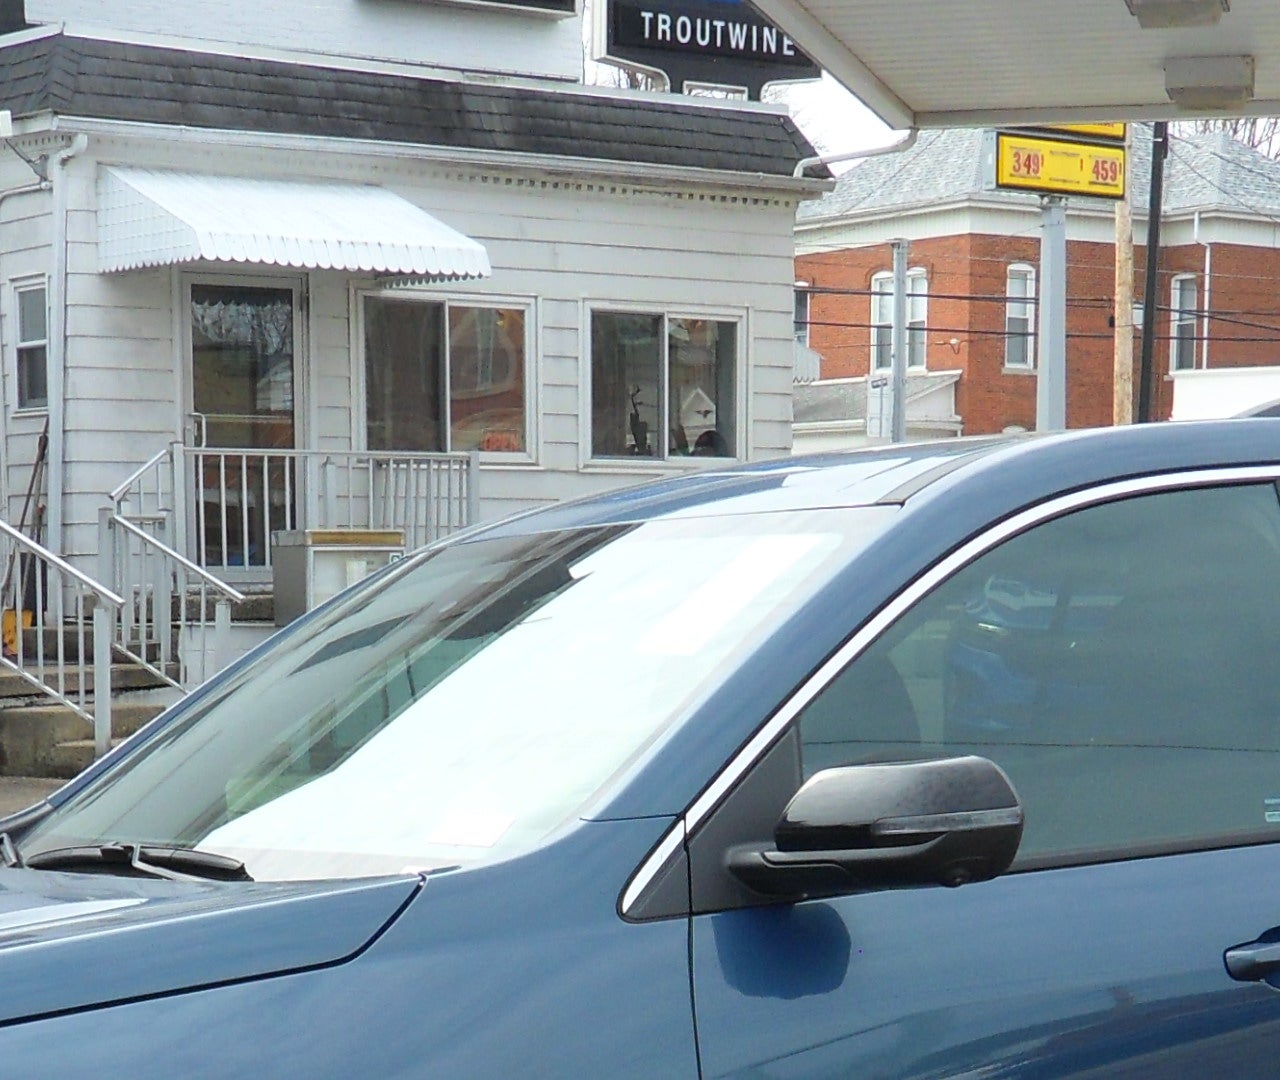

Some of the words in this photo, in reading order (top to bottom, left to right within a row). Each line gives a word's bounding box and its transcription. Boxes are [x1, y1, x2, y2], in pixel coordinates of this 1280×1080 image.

[641, 12, 795, 56] TROUTWINE
[1013, 152, 1039, 175] 349
[1092, 160, 1117, 182] 459
